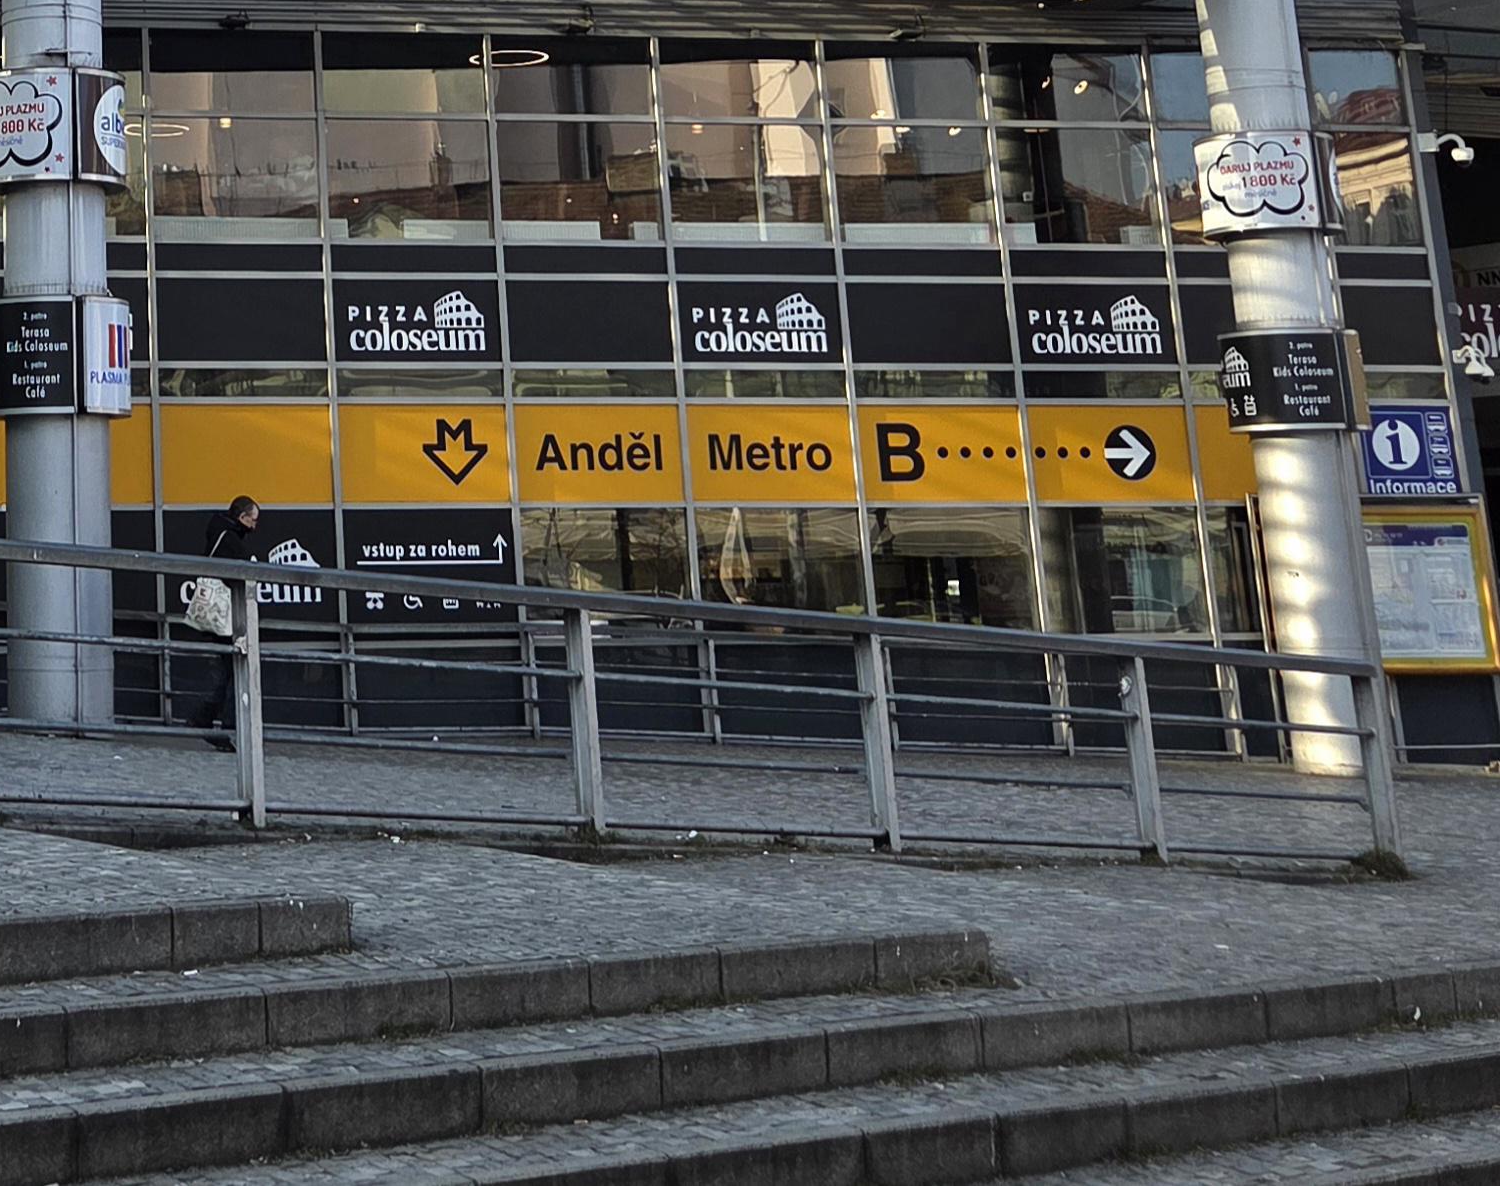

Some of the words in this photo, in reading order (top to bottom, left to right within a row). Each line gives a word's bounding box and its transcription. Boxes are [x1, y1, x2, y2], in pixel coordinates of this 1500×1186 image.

[5, 102, 45, 117] PLAZMU
[28, 117, 45, 132] Kč
[1253, 160, 1294, 172] PLAZMU
[1280, 173, 1296, 187] Kč
[348, 305, 428, 322] PIZZA
[691, 307, 770, 324] PIZZA
[1028, 309, 1105, 326] PIZZA
[21, 326, 50, 338] Terasa
[350, 321, 486, 351] coloseum
[694, 322, 828, 353] coloseum
[1031, 324, 1163, 354] coloseum
[6, 342, 23, 353] Kids
[24, 340, 69, 352] Coloseum
[1288, 354, 1317, 364] Terasa
[12, 373, 61, 385] Restaurant
[1273, 367, 1292, 377] Kids
[1293, 367, 1334, 376] Coloseum
[25, 386, 46, 398] Café
[1283, 394, 1331, 405] Restaurant
[1299, 406, 1320, 416] Café
[535, 431, 663, 471] Anděl
[707, 433, 833, 471] Metro
[875, 422, 925, 483] B
[1370, 480, 1457, 494] Informace
[362, 542, 404, 560] vstup
[408, 545, 427, 558] za
[430, 539, 481, 558] rohem
